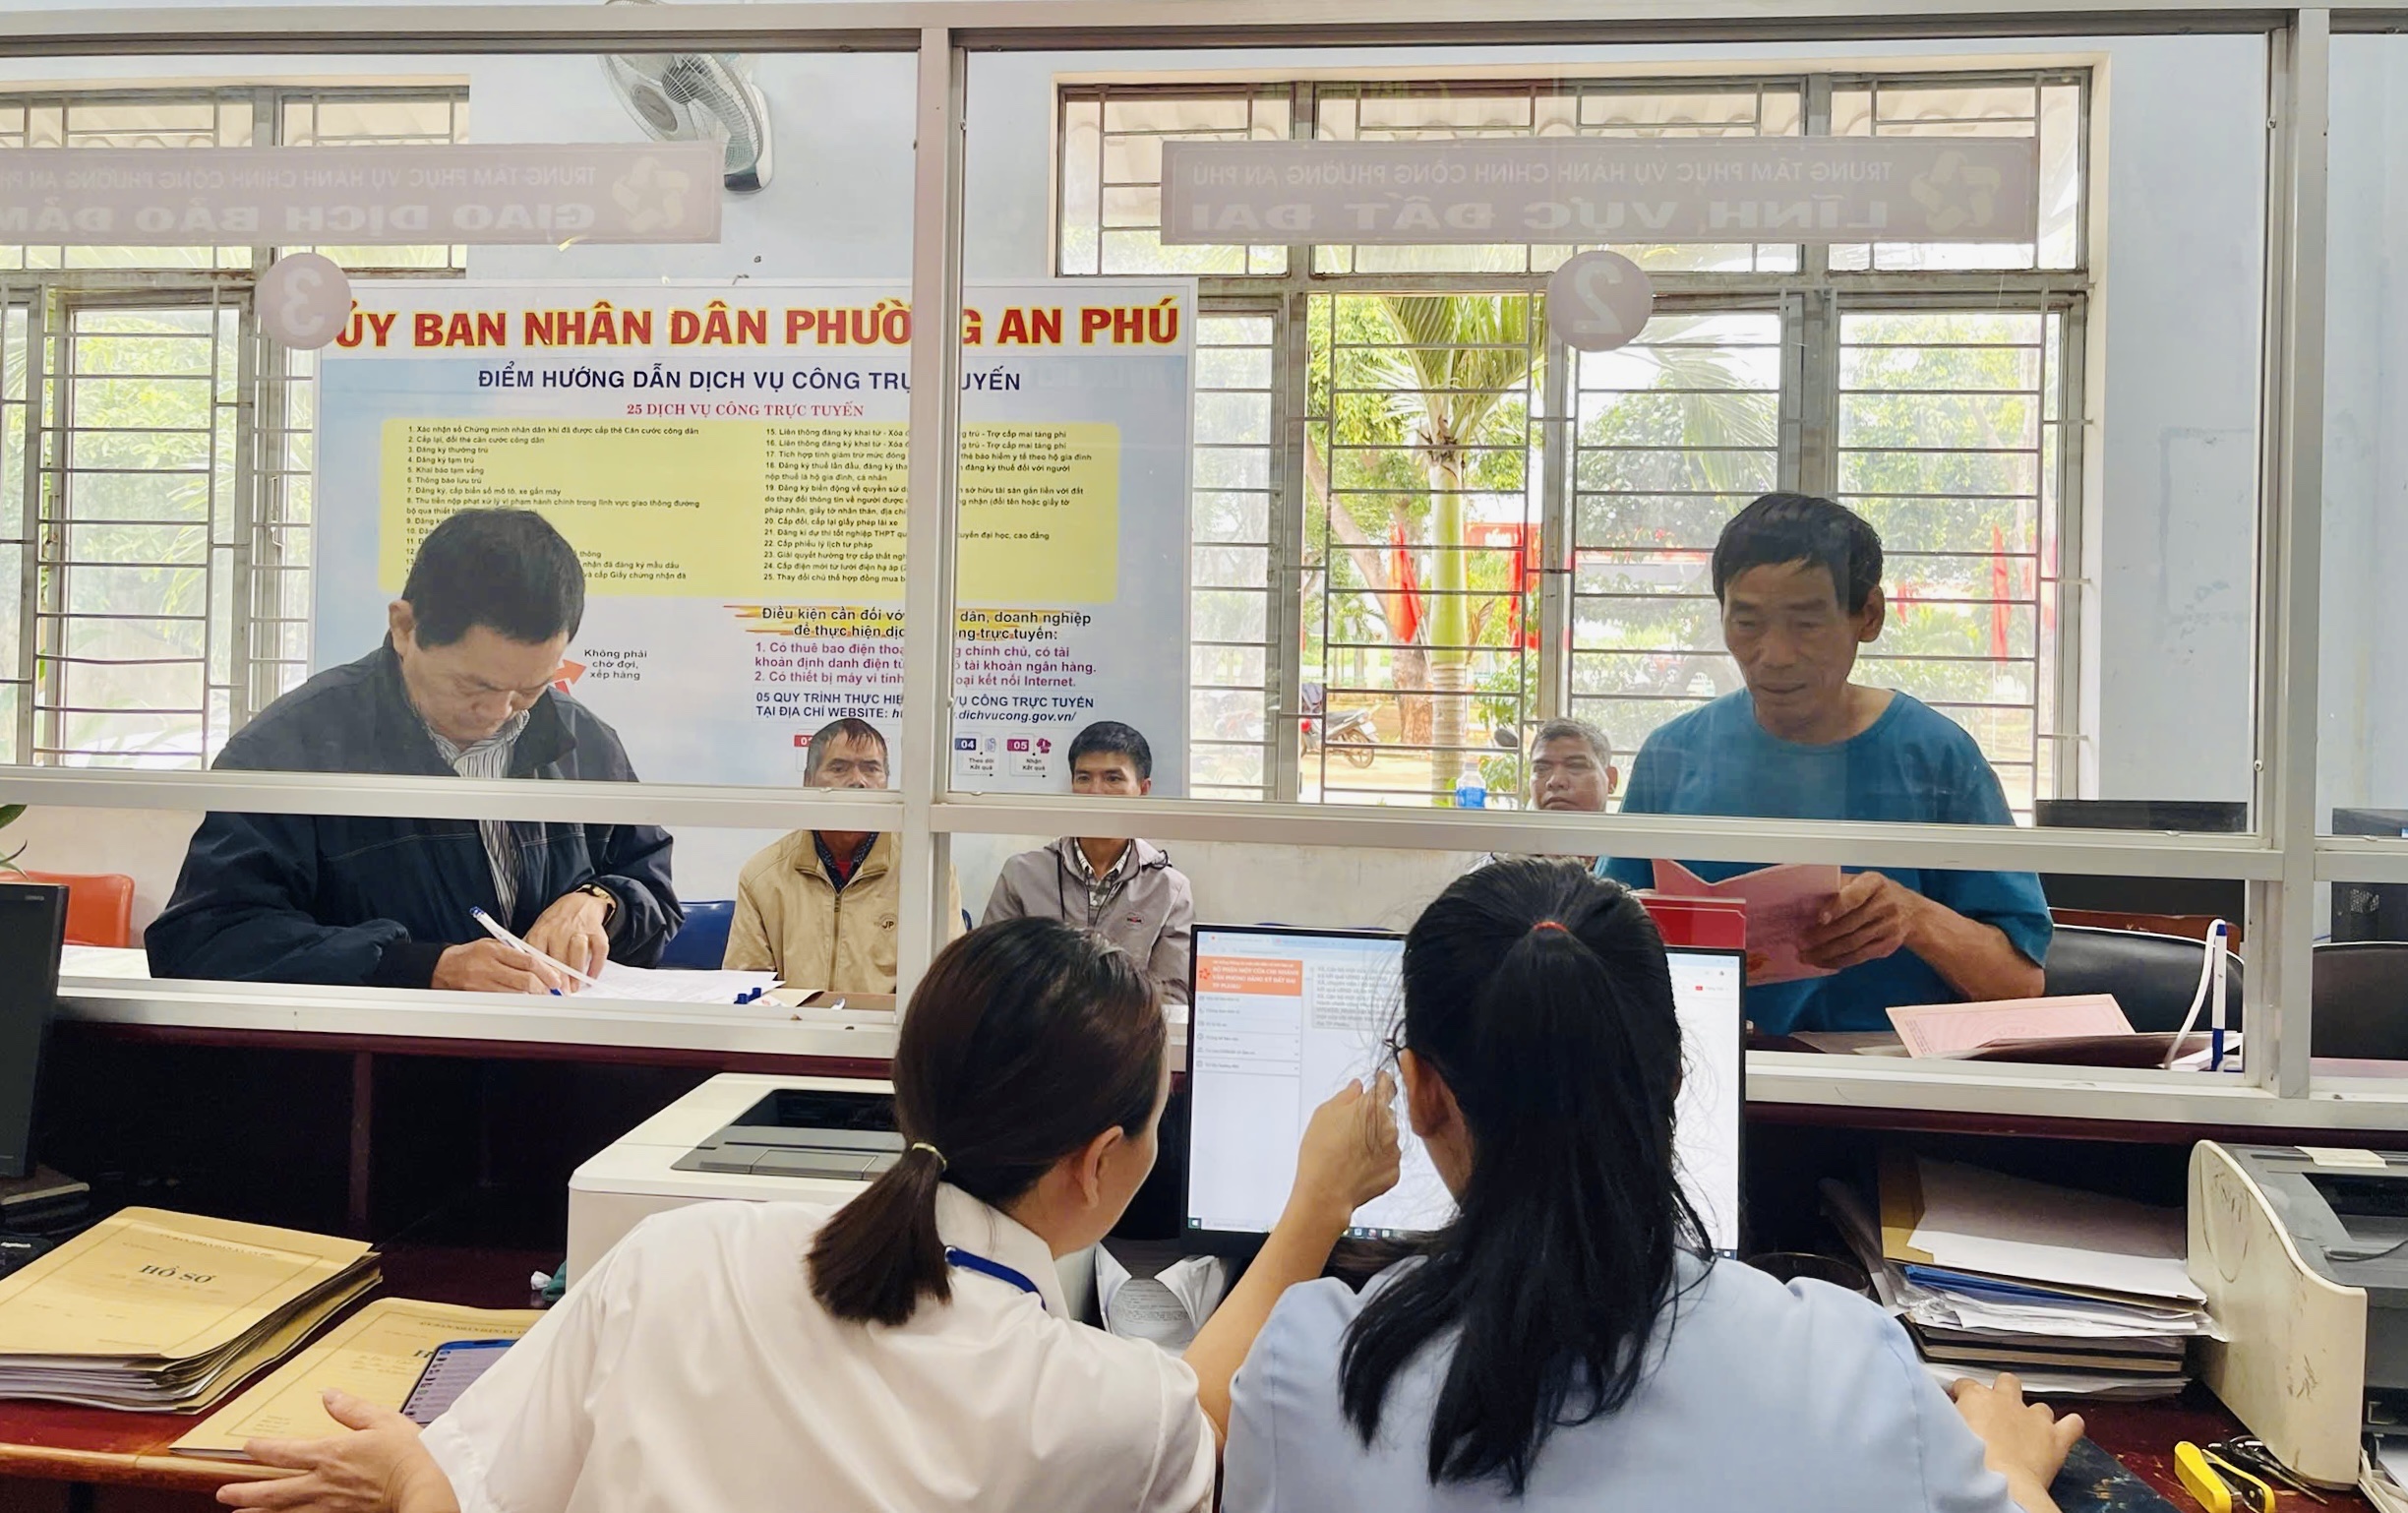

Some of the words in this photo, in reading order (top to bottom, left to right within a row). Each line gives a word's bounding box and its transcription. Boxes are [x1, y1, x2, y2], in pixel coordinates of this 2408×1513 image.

[414, 313, 506, 346] BAN
[525, 301, 651, 346] NHÂN
[671, 301, 766, 344] DÂN
[787, 299, 982, 344] PHƯỜG
[997, 309, 1061, 344] AN
[1081, 296, 1177, 344] PHÚ
[479, 361, 533, 387] ĐIỂM
[543, 366, 624, 388] HƯỚNG
[633, 363, 680, 388] DẪN
[691, 371, 744, 392] DỊCH
[753, 372, 783, 393] VỤ
[793, 367, 859, 389] CÔNG
[962, 366, 1019, 390] UYẾN
[627, 403, 642, 414] 25
[647, 403, 686, 418] DỊCH
[690, 403, 710, 418] VỤ
[715, 400, 759, 415] CÔNG
[764, 403, 808, 419] TRỰC
[811, 401, 865, 416] TUYẾN
[762, 605, 793, 619] Điều
[798, 608, 826, 620] kiện
[831, 606, 856, 620] cần
[861, 606, 881, 620] đối
[886, 609, 905, 620] vớ
[960, 611, 990, 624] dân,
[994, 611, 1038, 623] doanh
[1043, 612, 1091, 629] nghiệp
[794, 622, 811, 635] để
[815, 625, 847, 636] thực
[852, 626, 881, 637] hiện
[885, 626, 905, 640] dịc
[981, 630, 1009, 641] trực
[1014, 626, 1057, 641] tuyến:
[583, 649, 621, 660] Không
[624, 649, 648, 659] phải
[770, 642, 787, 652] Có
[791, 643, 817, 652] thuê
[822, 643, 845, 653] bao
[849, 643, 874, 656] điện
[966, 646, 999, 655] chính
[1035, 646, 1050, 657] có
[1054, 647, 1069, 657] tài
[755, 657, 792, 667] khoản
[797, 656, 823, 670] định
[828, 658, 859, 668] danh
[864, 658, 889, 671] điện
[965, 661, 979, 670] tài
[984, 660, 1022, 673] khoản
[1026, 662, 1057, 675] ngân
[589, 668, 610, 681] xếp
[613, 670, 641, 681] hàng
[769, 671, 786, 682] Có
[791, 671, 817, 683] thiết
[821, 673, 832, 685] bị
[837, 673, 863, 686] máy
[979, 673, 996, 685] kết
[1000, 673, 1020, 686] nối
[1024, 676, 1076, 687] Internet.
[756, 693, 770, 702] 05
[773, 693, 800, 704] QUY
[806, 691, 841, 703] TRÌNH
[845, 693, 879, 705] THỰC
[883, 694, 903, 705] HIỆ
[971, 694, 1008, 707] CÔNG
[1012, 696, 1048, 709] TRỰC
[1052, 693, 1095, 708] TUYẾN
[756, 705, 776, 718] TẠI
[779, 706, 801, 719] ĐỊA
[804, 704, 824, 717] CHỈ
[829, 706, 888, 719] WEBSITE:
[961, 740, 975, 749] 04
[1013, 741, 1028, 751] 05
[881, 921, 895, 930] JP
